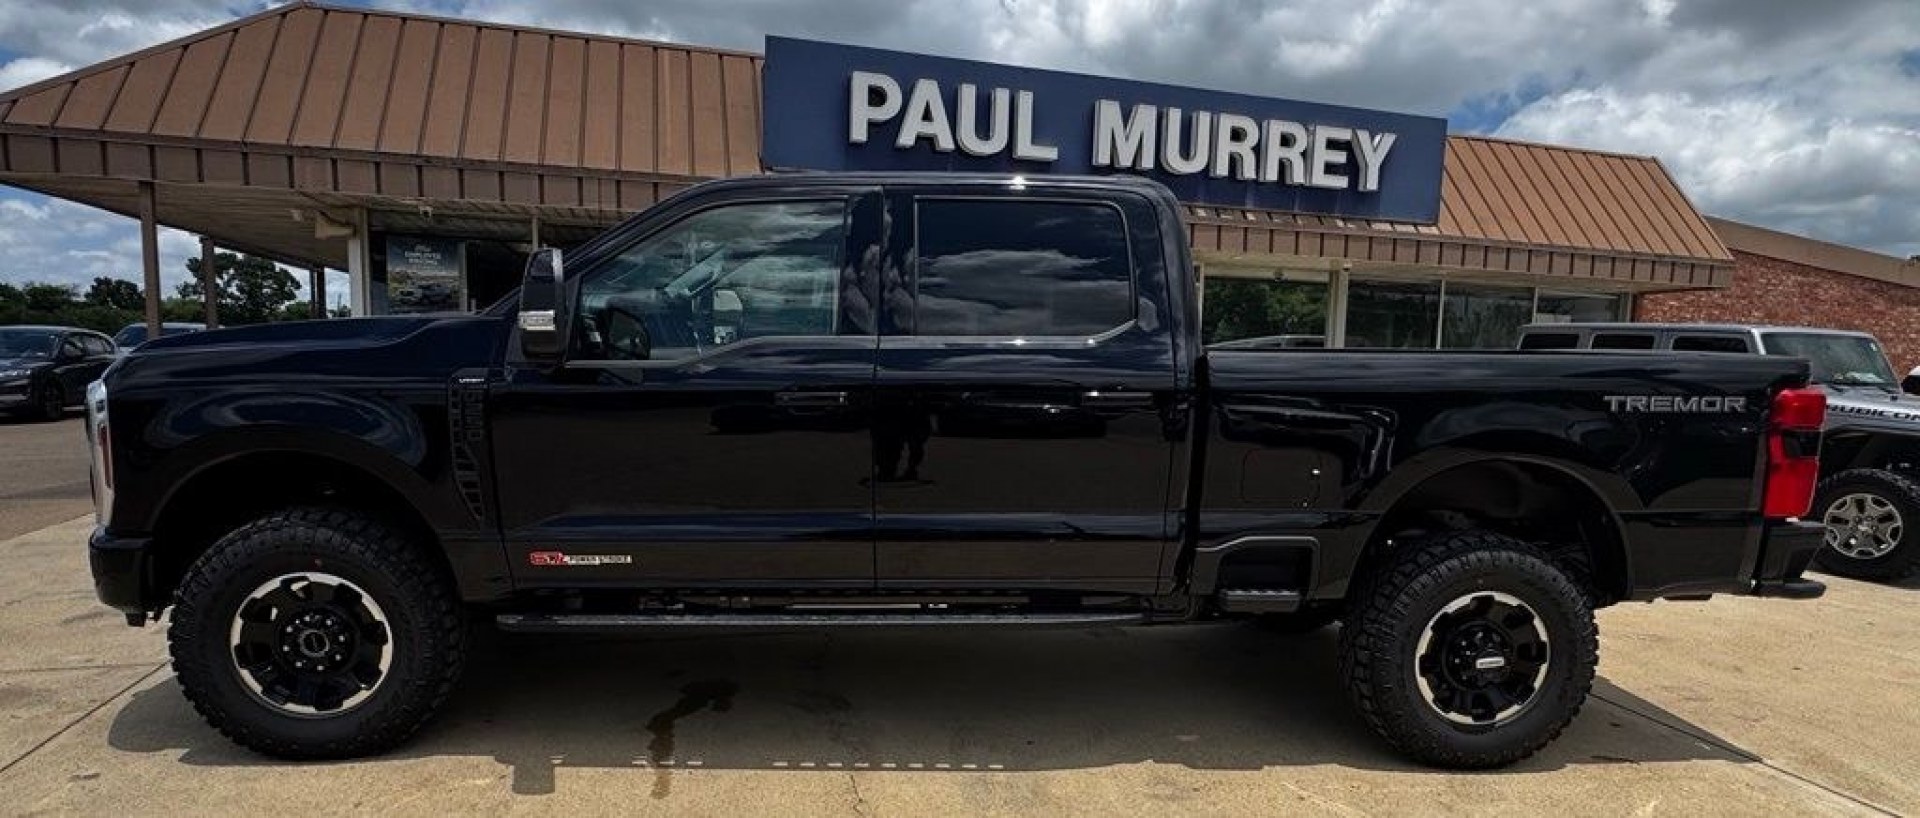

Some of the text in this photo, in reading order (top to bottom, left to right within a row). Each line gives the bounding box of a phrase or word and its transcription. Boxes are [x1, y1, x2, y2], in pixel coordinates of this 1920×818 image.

[849, 69, 1396, 192] PAUL MURREY
[1603, 396, 1746, 413] TREMOR
